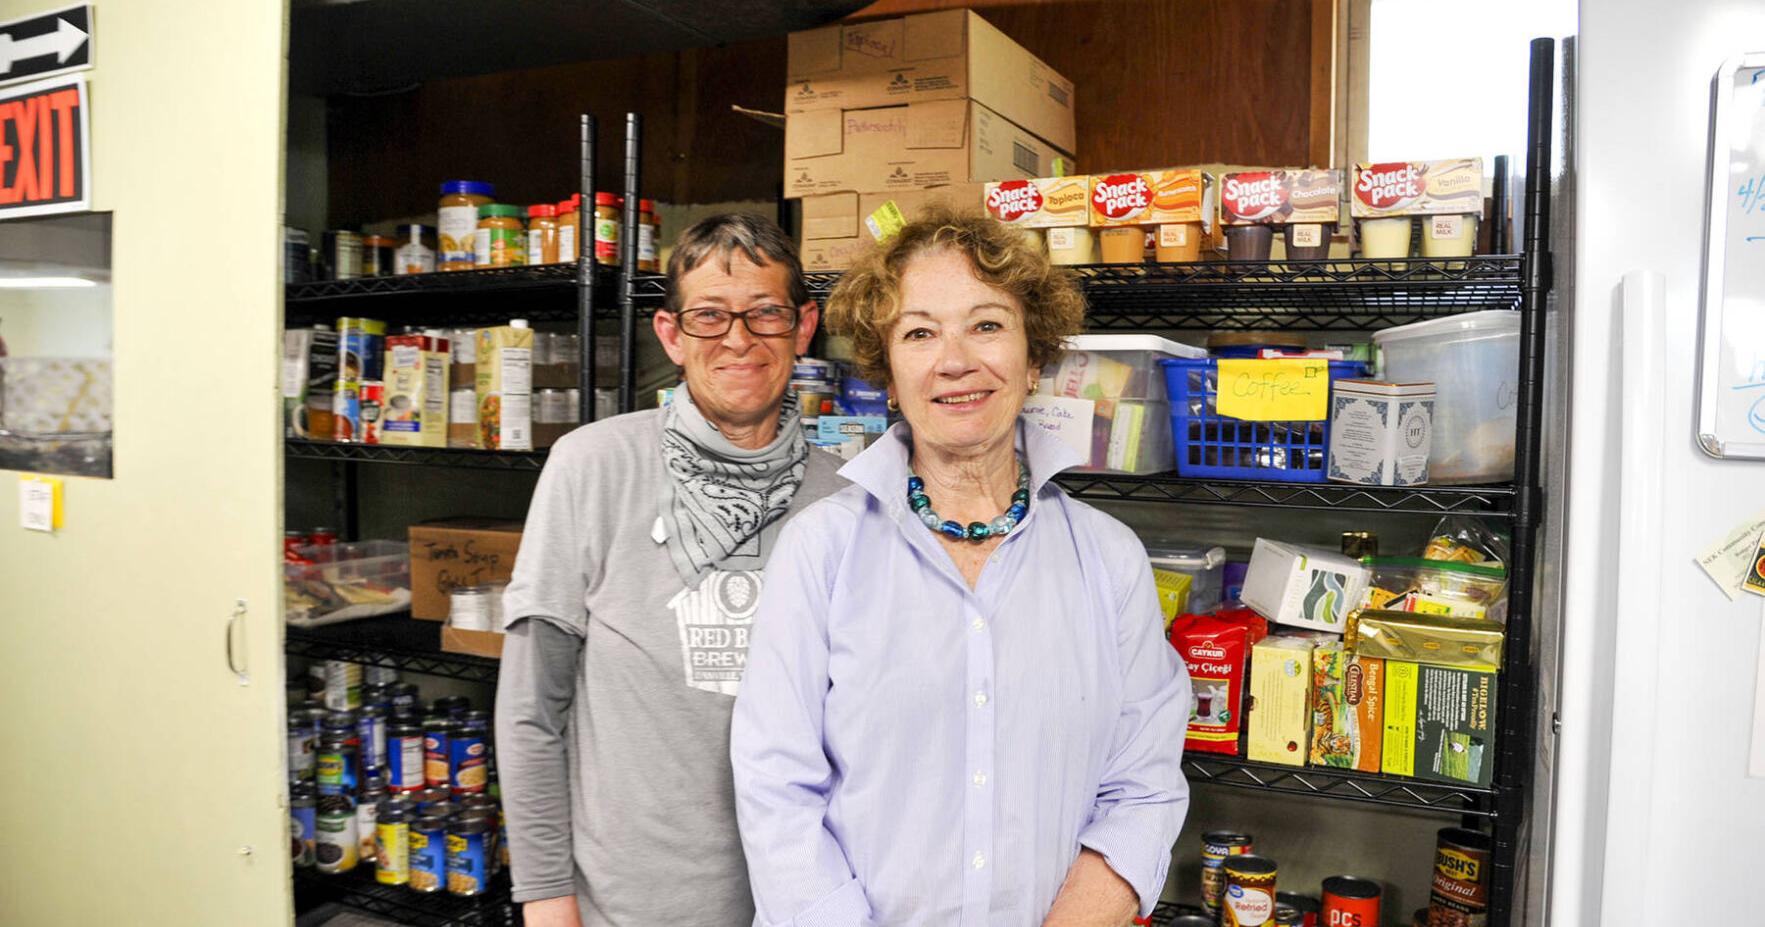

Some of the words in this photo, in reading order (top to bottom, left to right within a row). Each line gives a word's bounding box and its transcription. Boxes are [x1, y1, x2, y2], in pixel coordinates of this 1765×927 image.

[0, 88, 80, 205] EXIT
[1225, 174, 1282, 201] Snack
[1358, 165, 1421, 192] Snack
[1437, 174, 1471, 188] Vanilla
[988, 181, 1039, 207] Snack
[1048, 192, 1085, 207] Tapioca
[1093, 177, 1148, 204] Snack
[1238, 191, 1281, 212] pack
[1291, 185, 1336, 199] Chocolate
[1371, 182, 1419, 205] pack
[1000, 197, 1038, 219] pack
[1106, 192, 1147, 215] pack
[688, 627, 731, 648] RED
[1366, 663, 1379, 695] Bengal
[1366, 696, 1379, 721] Spice
[1477, 676, 1489, 730] BIGELOW
[1235, 901, 1268, 912] Refried
